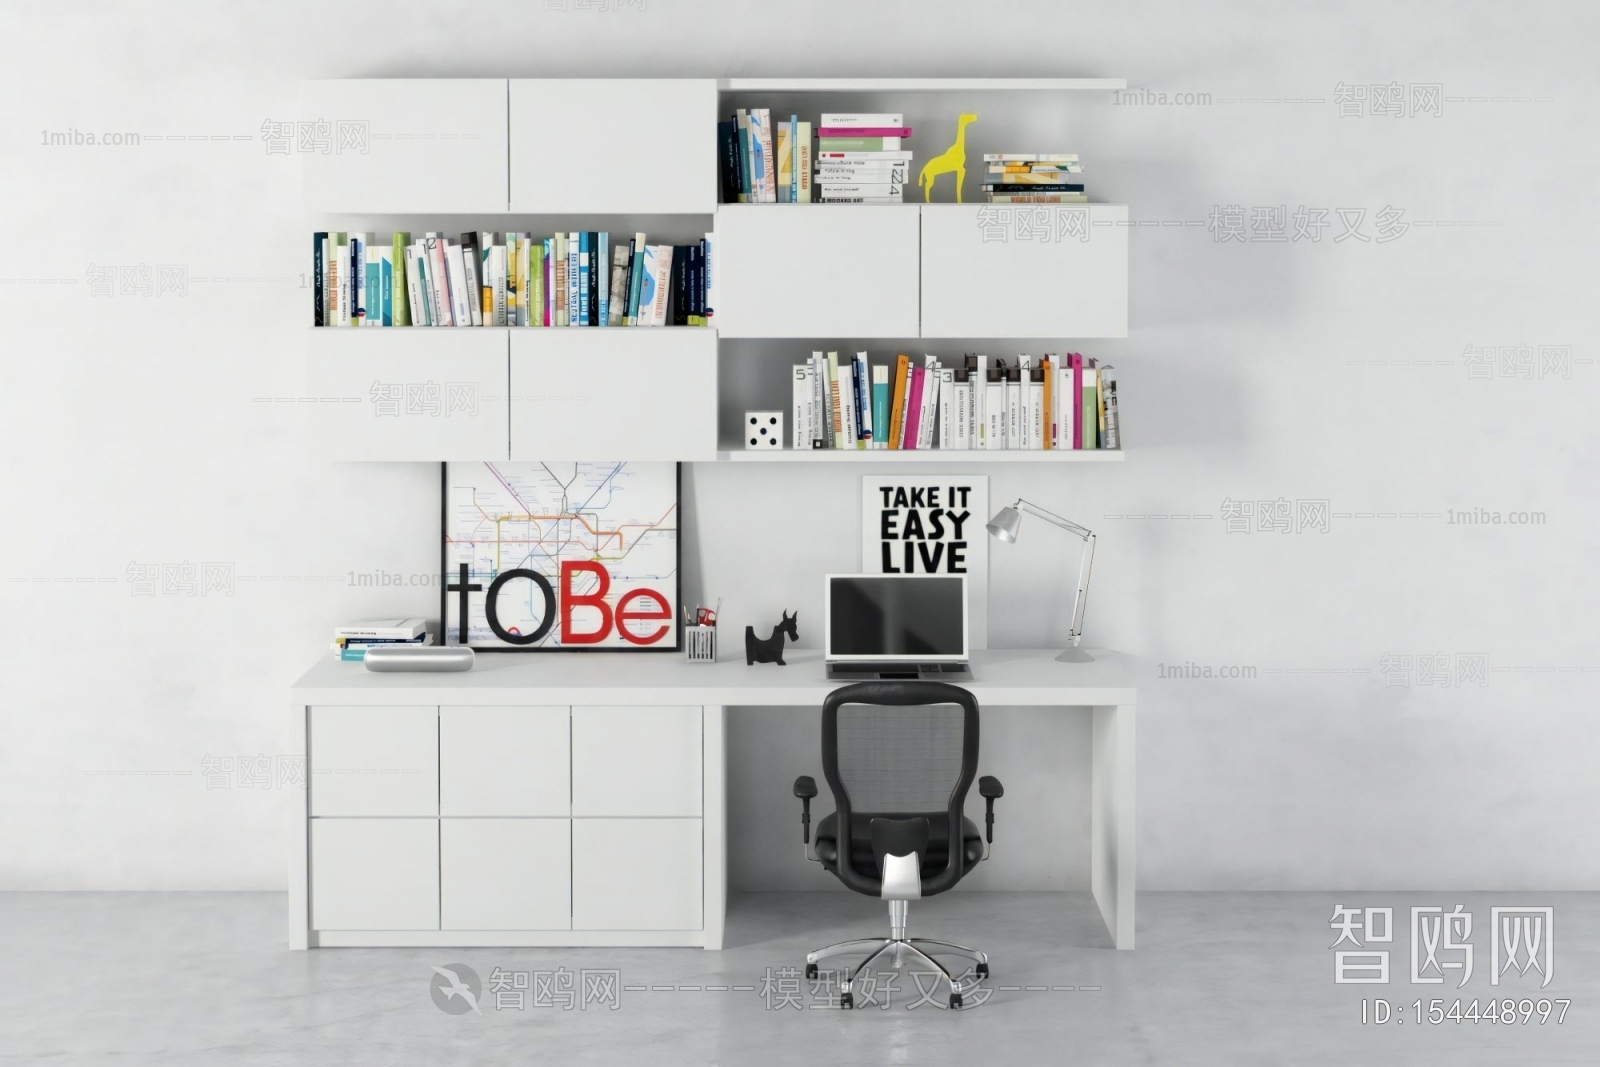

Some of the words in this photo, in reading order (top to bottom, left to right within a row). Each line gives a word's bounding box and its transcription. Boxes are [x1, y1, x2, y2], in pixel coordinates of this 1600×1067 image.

[879, 486, 940, 508] TAKE
[948, 486, 972, 508] IT
[880, 508, 971, 540] EASY
[881, 541, 968, 573] LIVE
[447, 560, 672, 645] toBe
